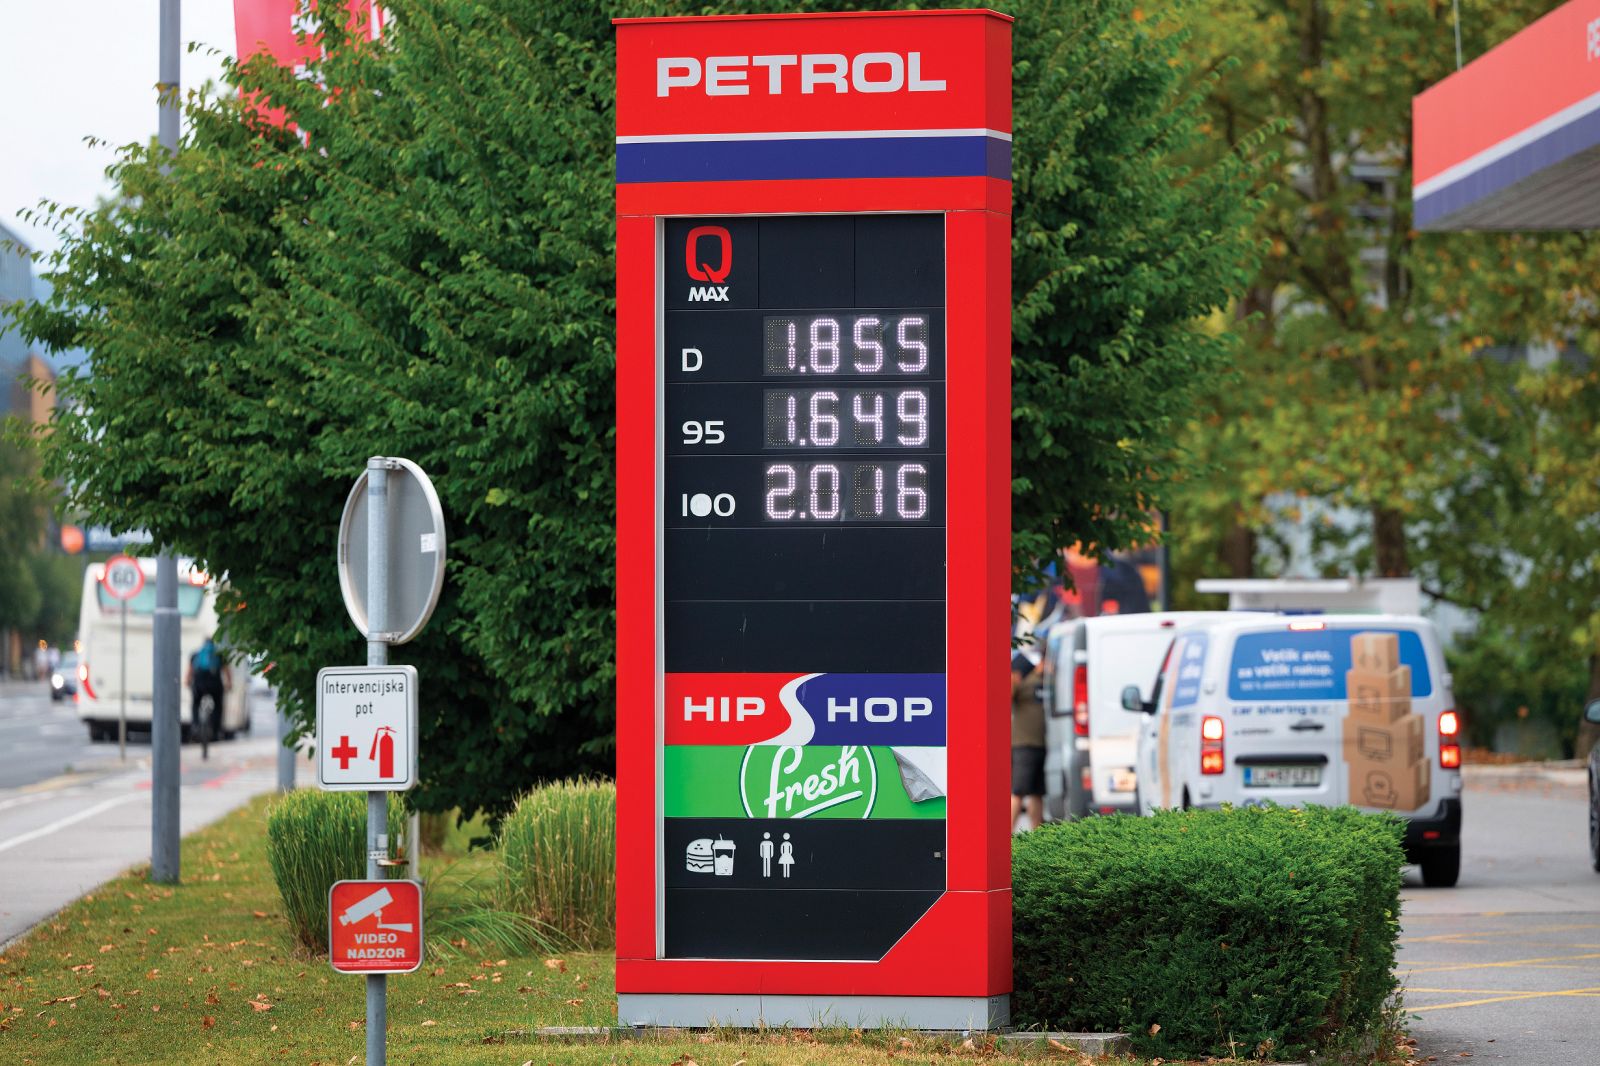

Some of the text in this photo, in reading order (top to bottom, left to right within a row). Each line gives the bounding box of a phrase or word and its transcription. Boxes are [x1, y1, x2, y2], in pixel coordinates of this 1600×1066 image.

[657, 51, 947, 98] PETROL
[685, 225, 733, 284] Q
[688, 286, 730, 302] MAX
[681, 317, 927, 374] D 1.855
[682, 390, 927, 447] 95 1.649
[766, 464, 927, 519] 2.016
[325, 679, 404, 696] Intervencijska
[355, 701, 373, 718] pot
[683, 696, 933, 723] HIP HOP
[763, 745, 860, 818] fresh
[346, 947, 405, 959] NADZOR
[354, 933, 397, 944] VIDEO
